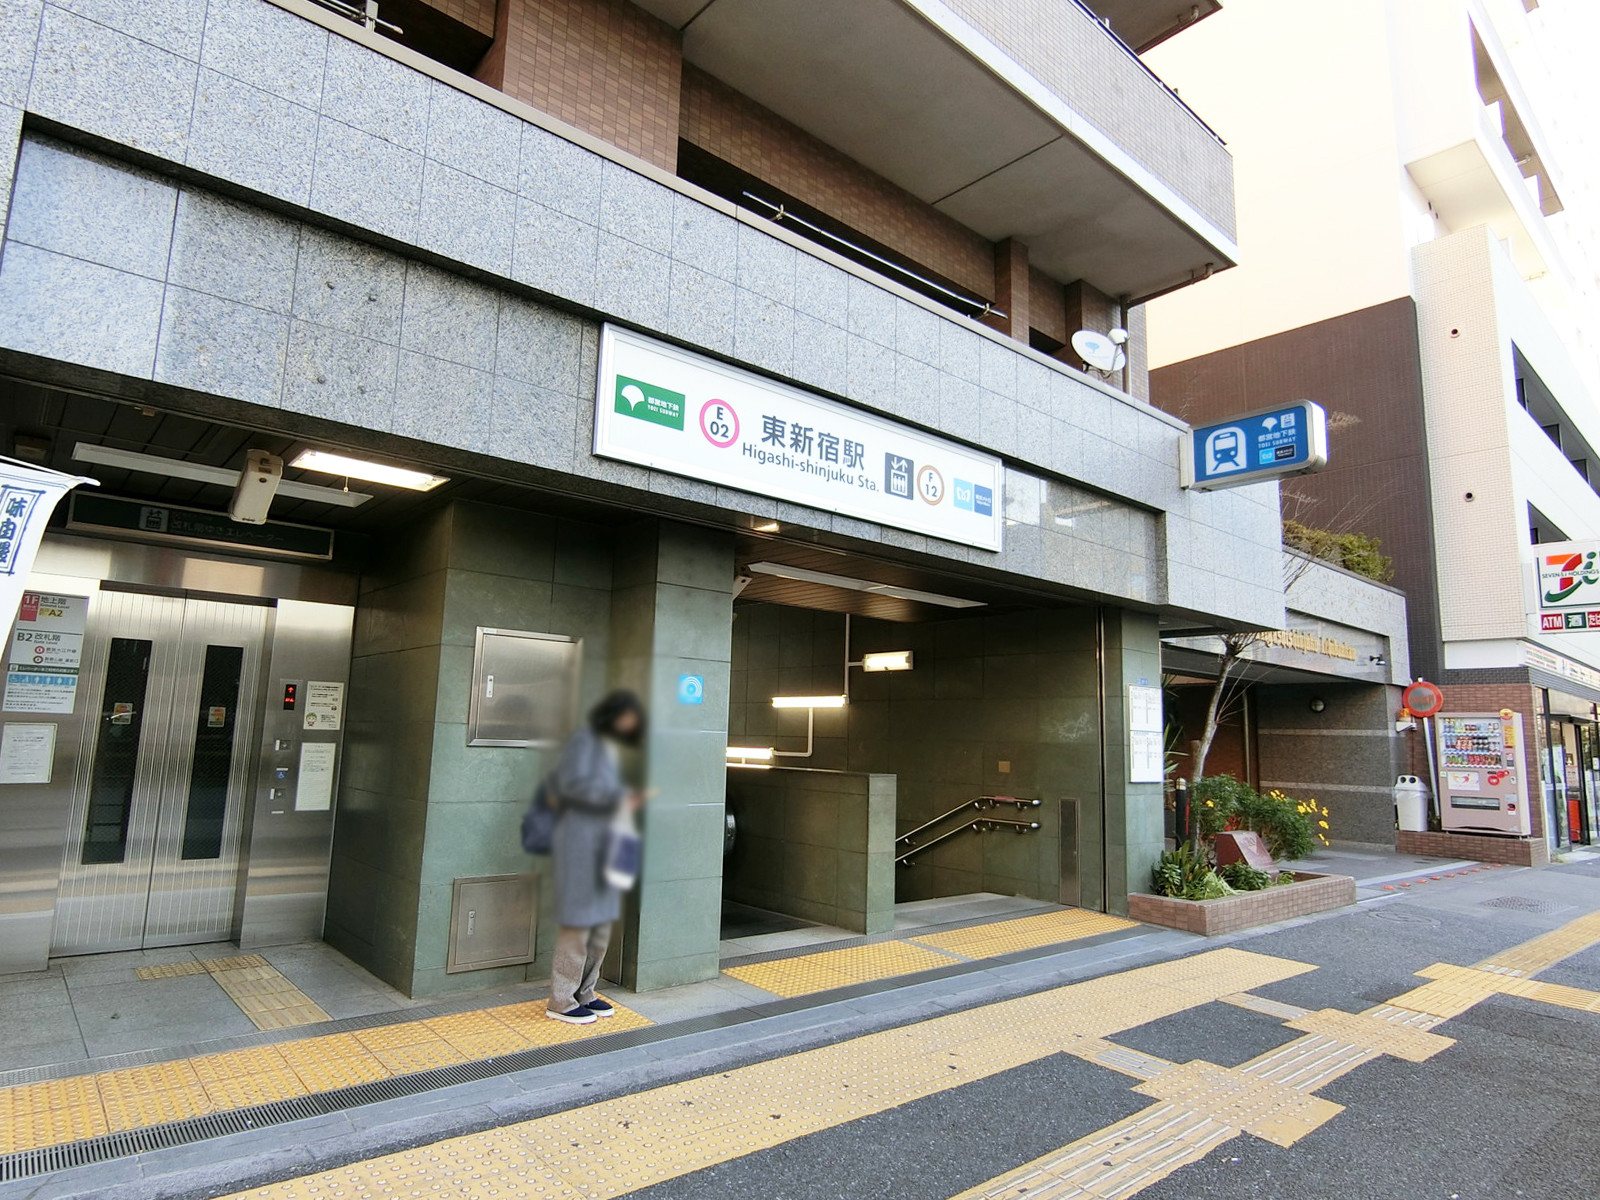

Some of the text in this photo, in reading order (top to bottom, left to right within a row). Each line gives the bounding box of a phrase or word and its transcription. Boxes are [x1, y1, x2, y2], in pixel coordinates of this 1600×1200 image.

[716, 406, 724, 421] E
[710, 421, 729, 438] 02
[761, 414, 865, 471] 東新宿駅
[1272, 437, 1296, 446] SUBWAY
[742, 442, 880, 492] Higashi-shinjuku Sta.
[928, 472, 934, 482] F
[925, 483, 938, 498] 12
[24, 595, 39, 605] 1F
[48, 609, 63, 617] A2
[1542, 616, 1562, 629] ATM
[1568, 614, 1582, 627] 酒
[17, 632, 33, 642] B2
